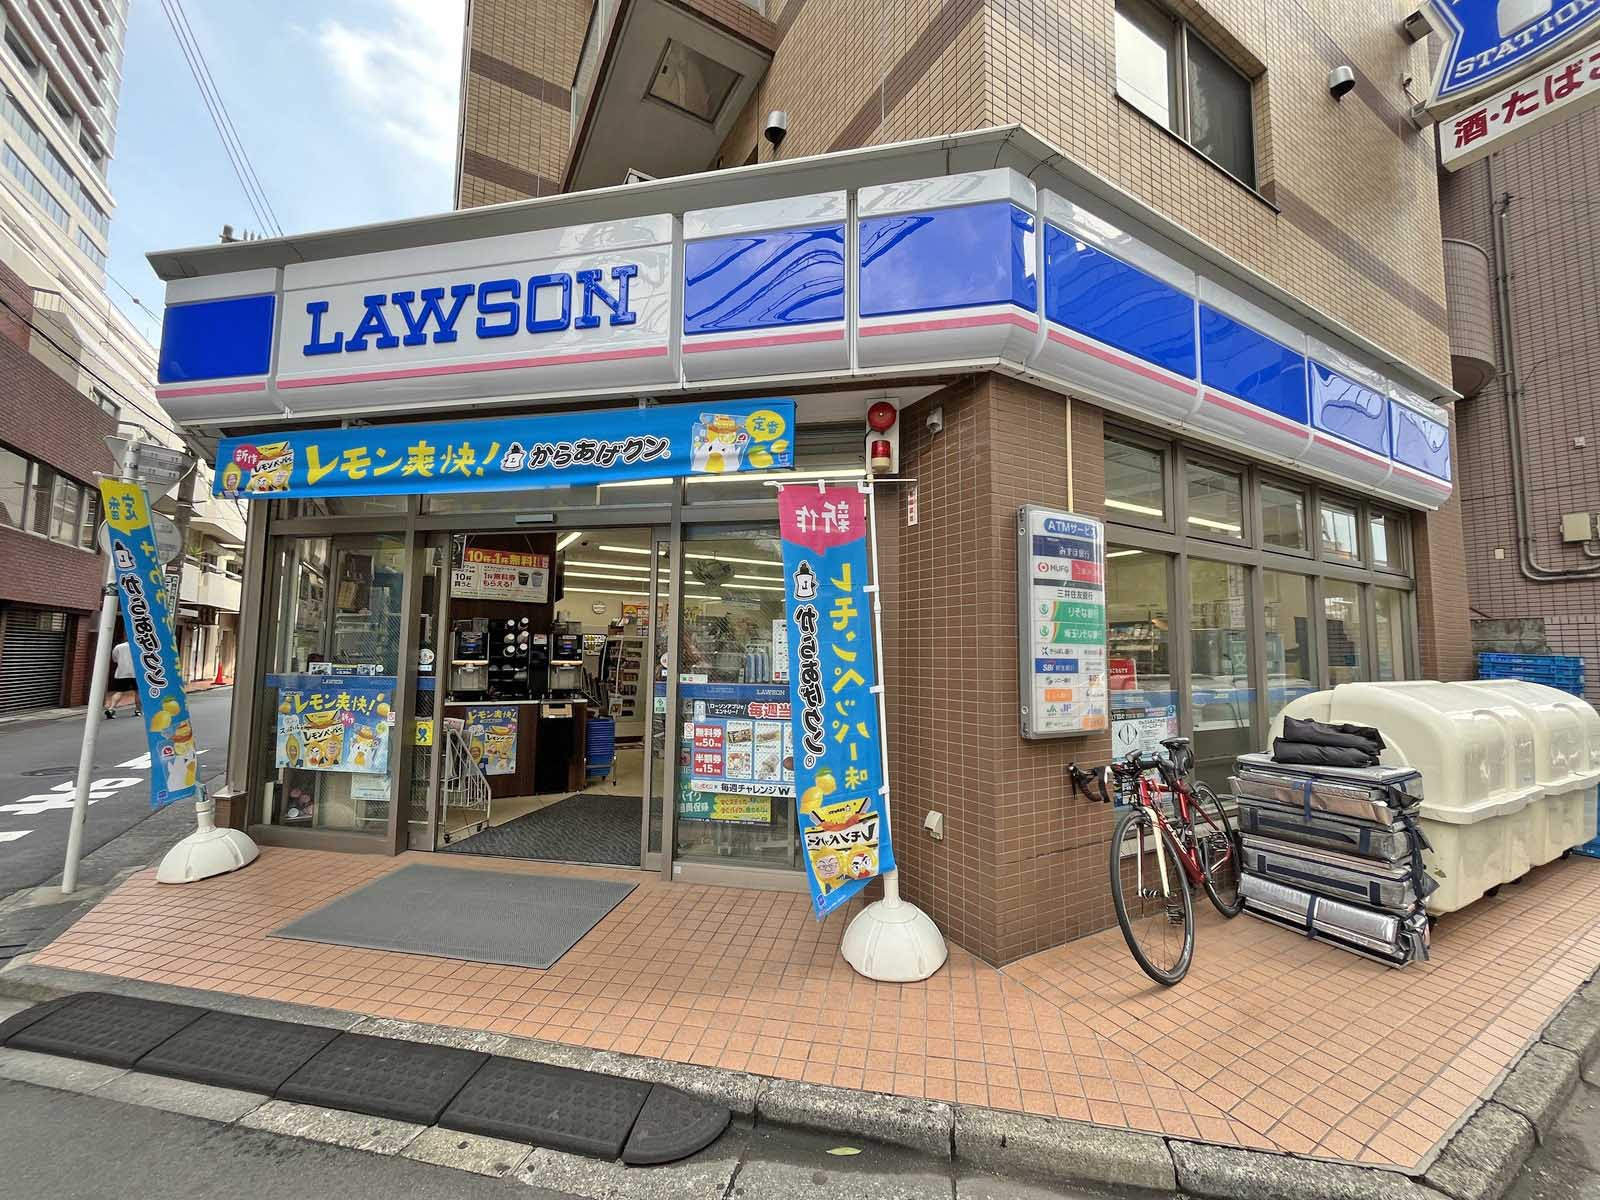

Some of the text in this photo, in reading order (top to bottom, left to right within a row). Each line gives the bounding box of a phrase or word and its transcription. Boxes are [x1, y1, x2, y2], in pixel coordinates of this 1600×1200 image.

[302, 264, 639, 357] LAWSON
[752, 416, 779, 434] 定番
[236, 449, 258, 464] 新作
[305, 440, 500, 485] レモン爽快!
[529, 435, 669, 468] からあげクン
